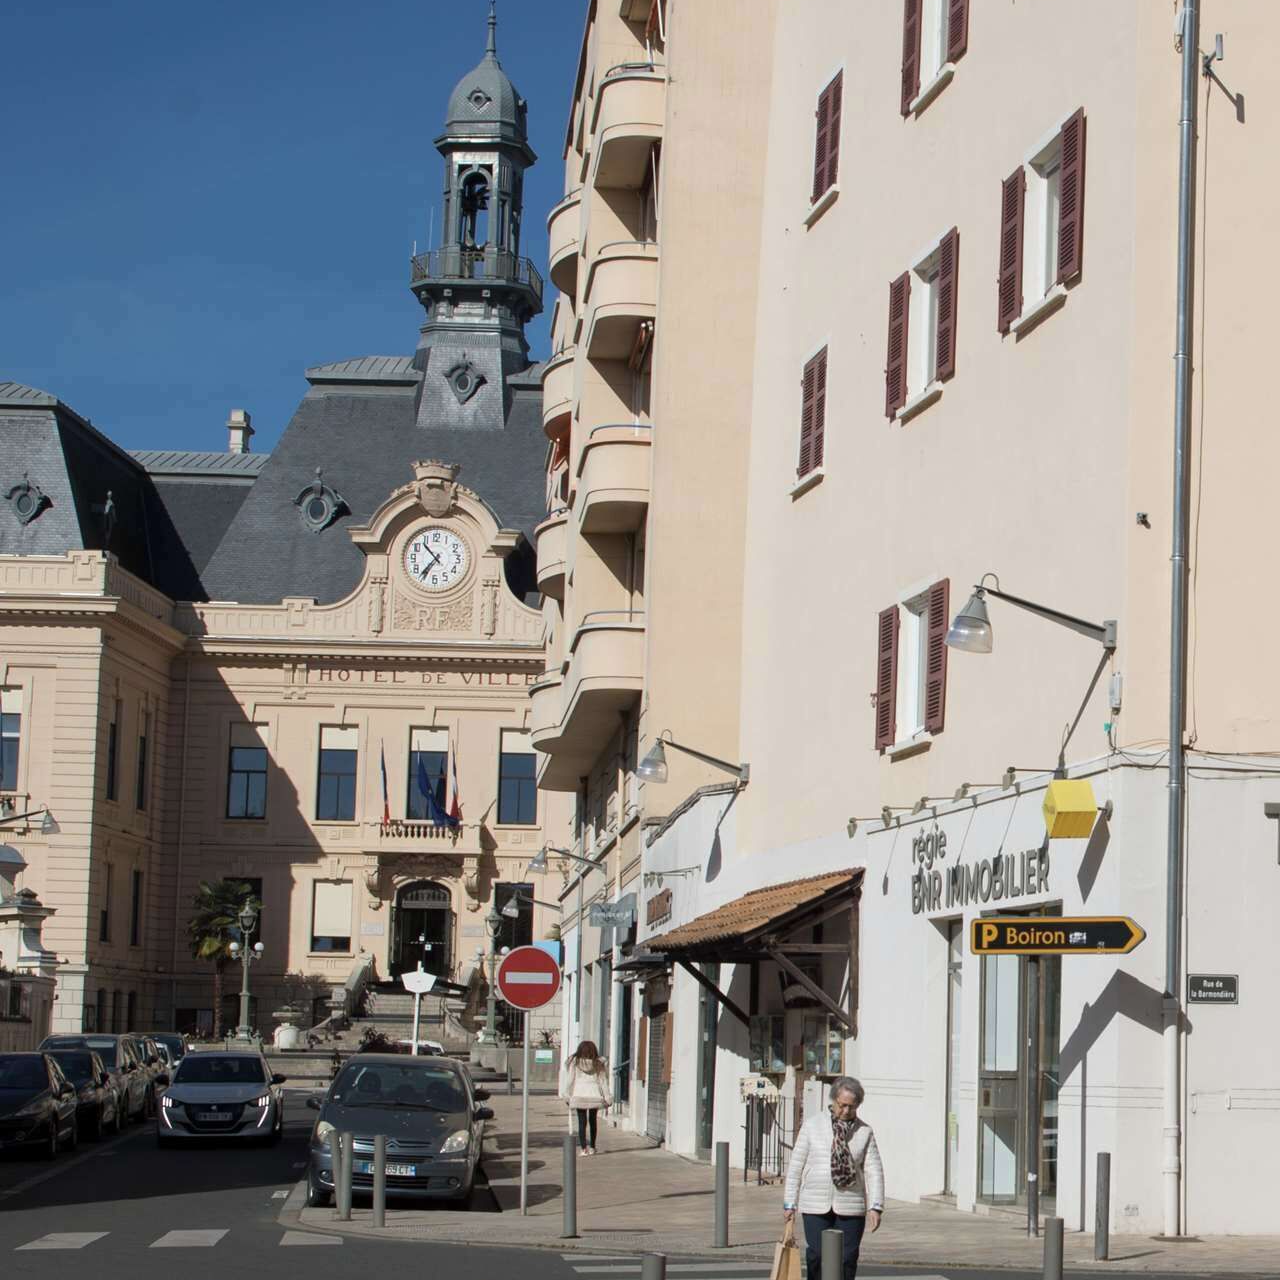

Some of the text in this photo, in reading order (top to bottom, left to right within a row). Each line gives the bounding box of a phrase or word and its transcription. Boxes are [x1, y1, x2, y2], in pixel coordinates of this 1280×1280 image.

[432, 533, 440, 542] 12
[414, 543, 421, 552] 10
[452, 544, 459, 553] 2
[411, 553, 416, 563] 9
[455, 554, 461, 564] 3
[413, 564, 419, 574] 8
[451, 565, 457, 574] 4
[432, 575, 438, 584] 6
[442, 572, 448, 581] 5
[422, 673, 447, 684] DE
[462, 672, 536, 686] VILLE
[912, 823, 947, 870] régie
[912, 848, 1050, 914] BNR IMMOBILIER
[982, 924, 1065, 948] P Boiron
[1215, 980, 1223, 988] de
